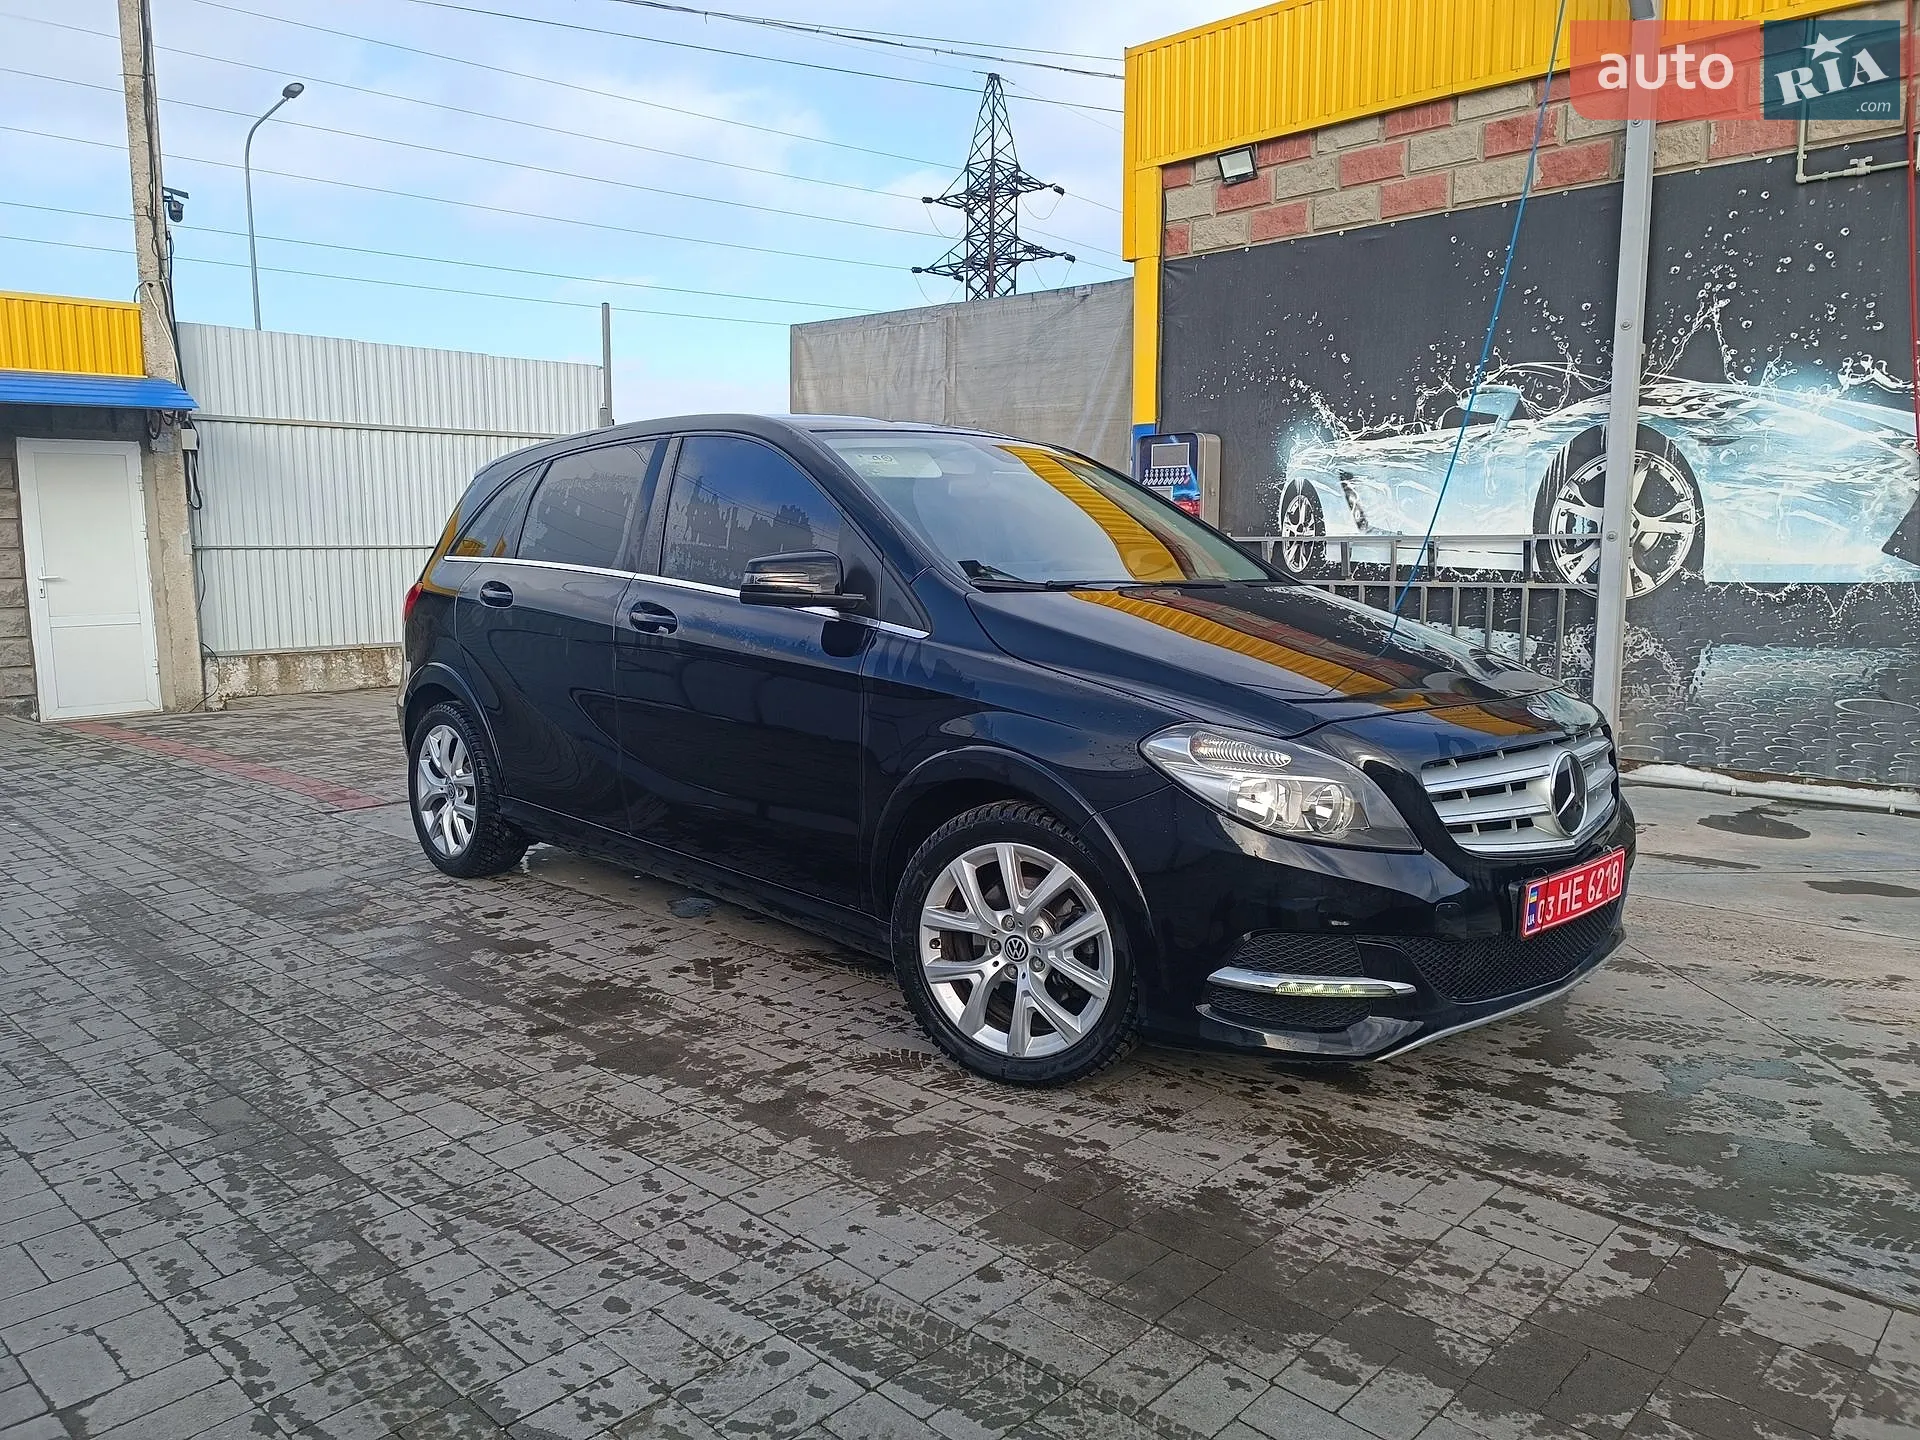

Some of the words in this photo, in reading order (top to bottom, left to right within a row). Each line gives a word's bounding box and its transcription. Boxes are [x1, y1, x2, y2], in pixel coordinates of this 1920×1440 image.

[1537, 895, 1555, 924] 03
[1557, 875, 1584, 916] HE
[1587, 860, 1620, 904] 6218
